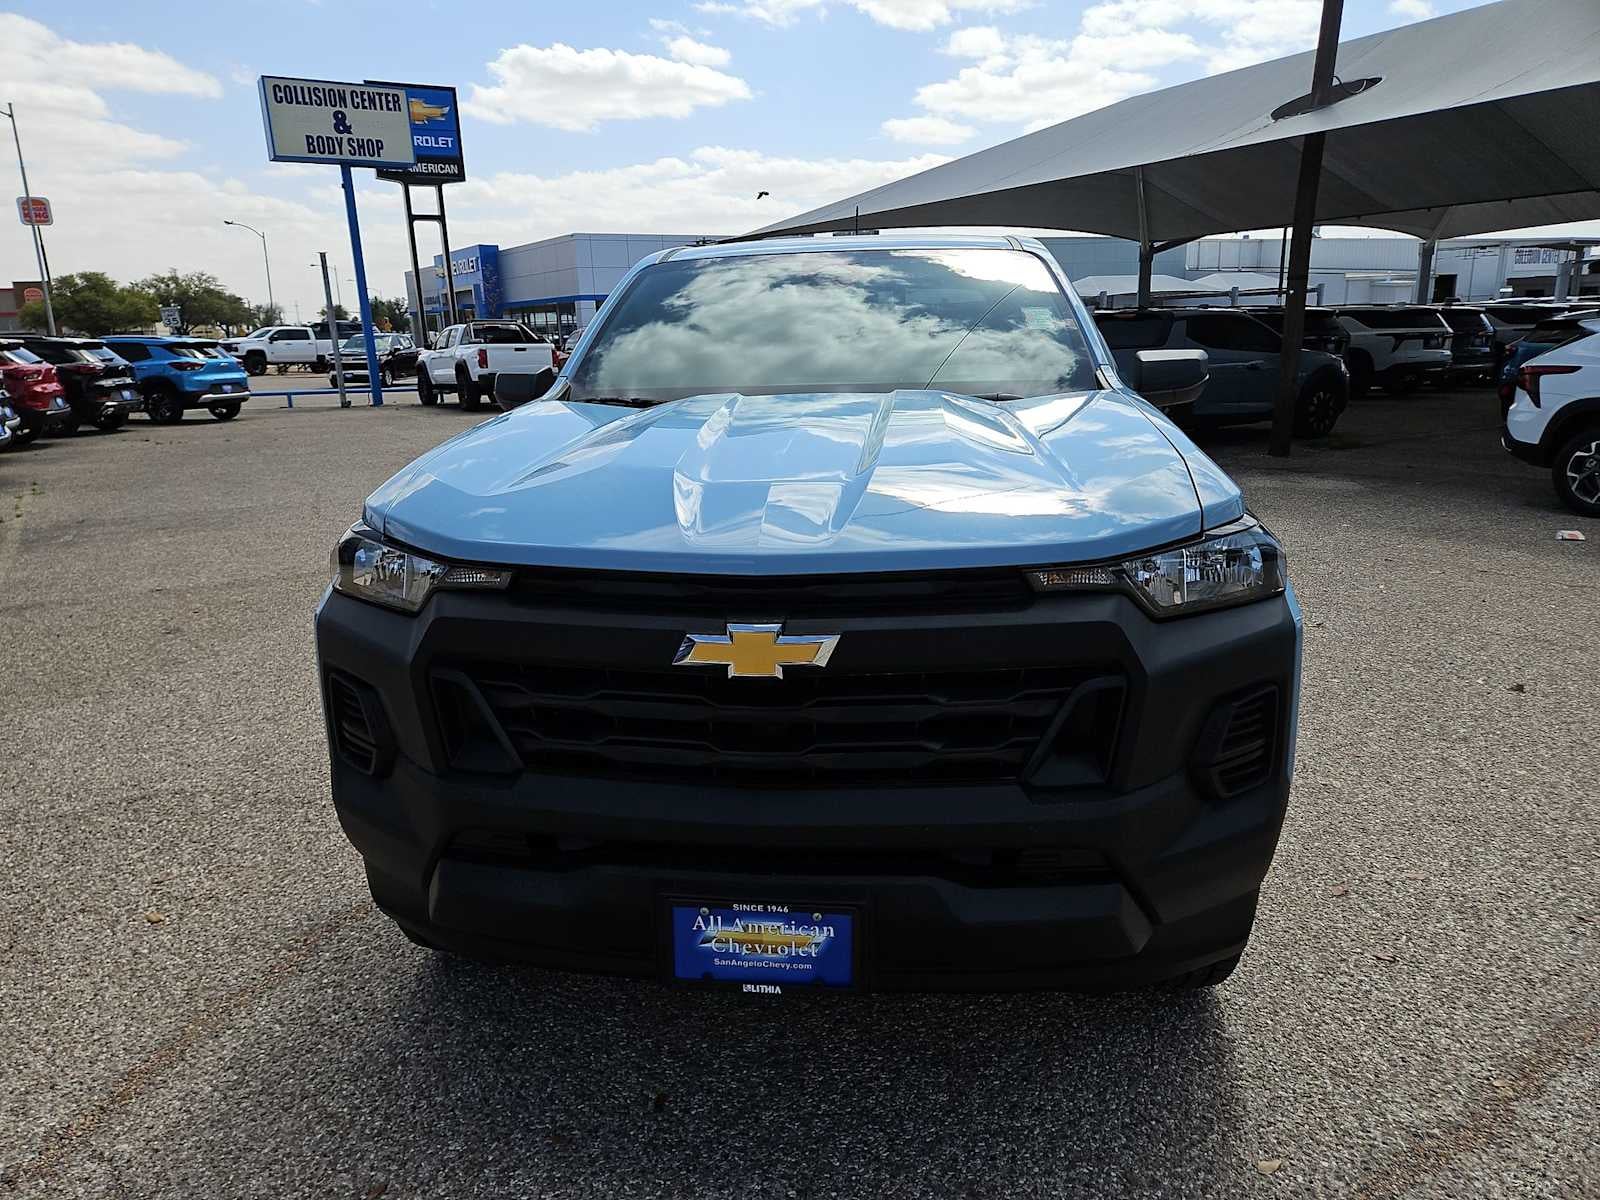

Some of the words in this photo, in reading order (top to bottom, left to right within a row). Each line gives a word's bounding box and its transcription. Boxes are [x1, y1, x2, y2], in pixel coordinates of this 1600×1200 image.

[272, 83, 348, 109] COLLISION
[350, 90, 402, 112] CENTER
[332, 110, 353, 135] &
[305, 134, 344, 155] BODY
[347, 138, 384, 158] SHOP
[413, 135, 454, 148] ROLET
[452, 257, 478, 276] EVROLET
[732, 903, 764, 912] SINCE
[767, 905, 789, 913] 1946
[692, 915, 722, 931] All
[731, 918, 835, 937] American
[711, 937, 818, 957] Chevrolet
[713, 958, 813, 970] SanAngeloChevy.com
[751, 984, 782, 994] LITHIA
